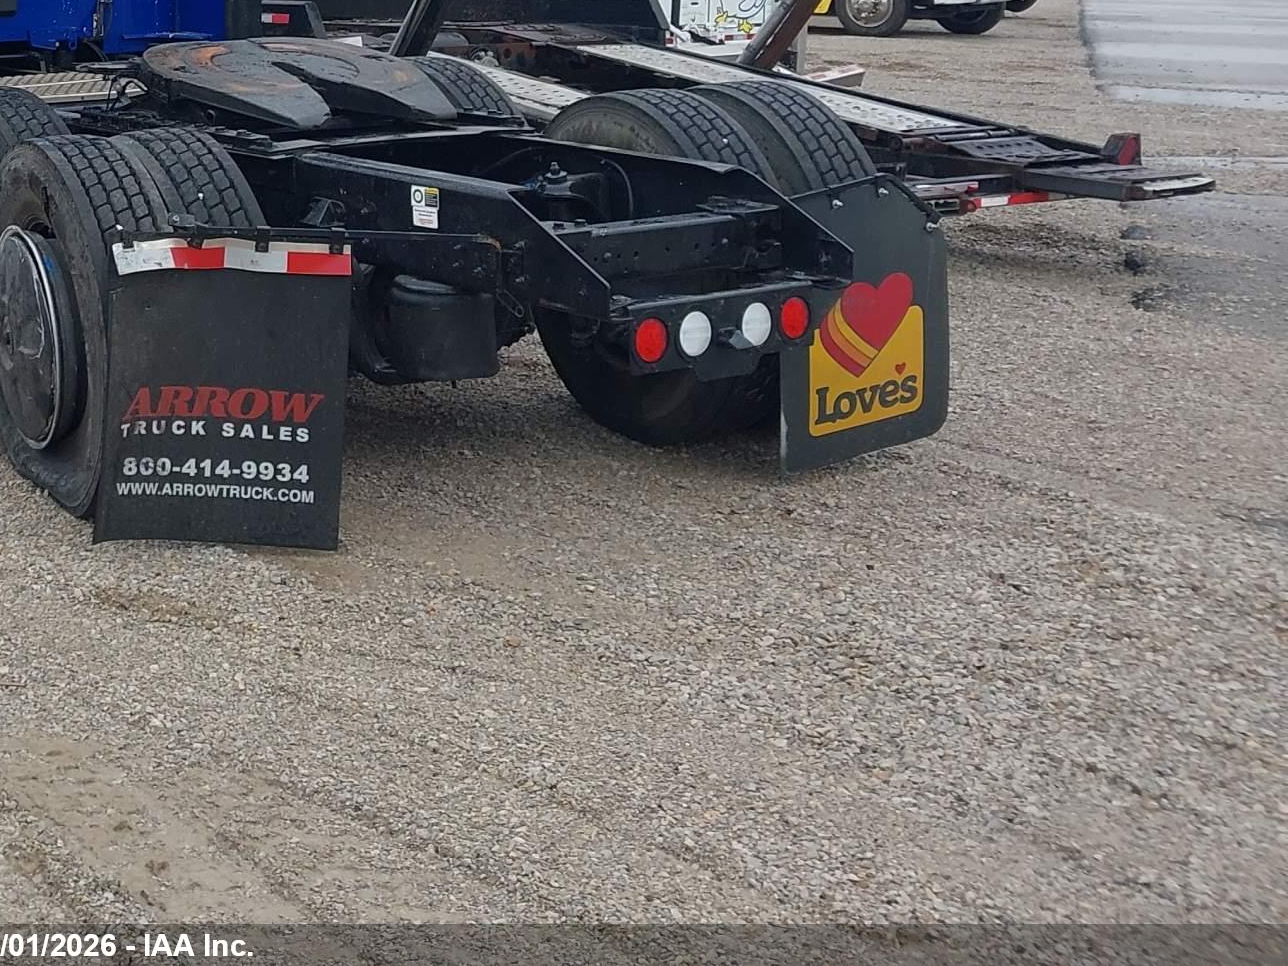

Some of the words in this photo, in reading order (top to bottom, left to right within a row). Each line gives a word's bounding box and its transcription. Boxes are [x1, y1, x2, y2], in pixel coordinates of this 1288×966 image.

[121, 386, 325, 423] ARROW
[120, 420, 206, 438] TRUCK
[221, 422, 310, 442] SALES
[122, 456, 309, 484] 800-414-9934
[116, 482, 314, 503] WWW.ARROWTRUCK.COM
